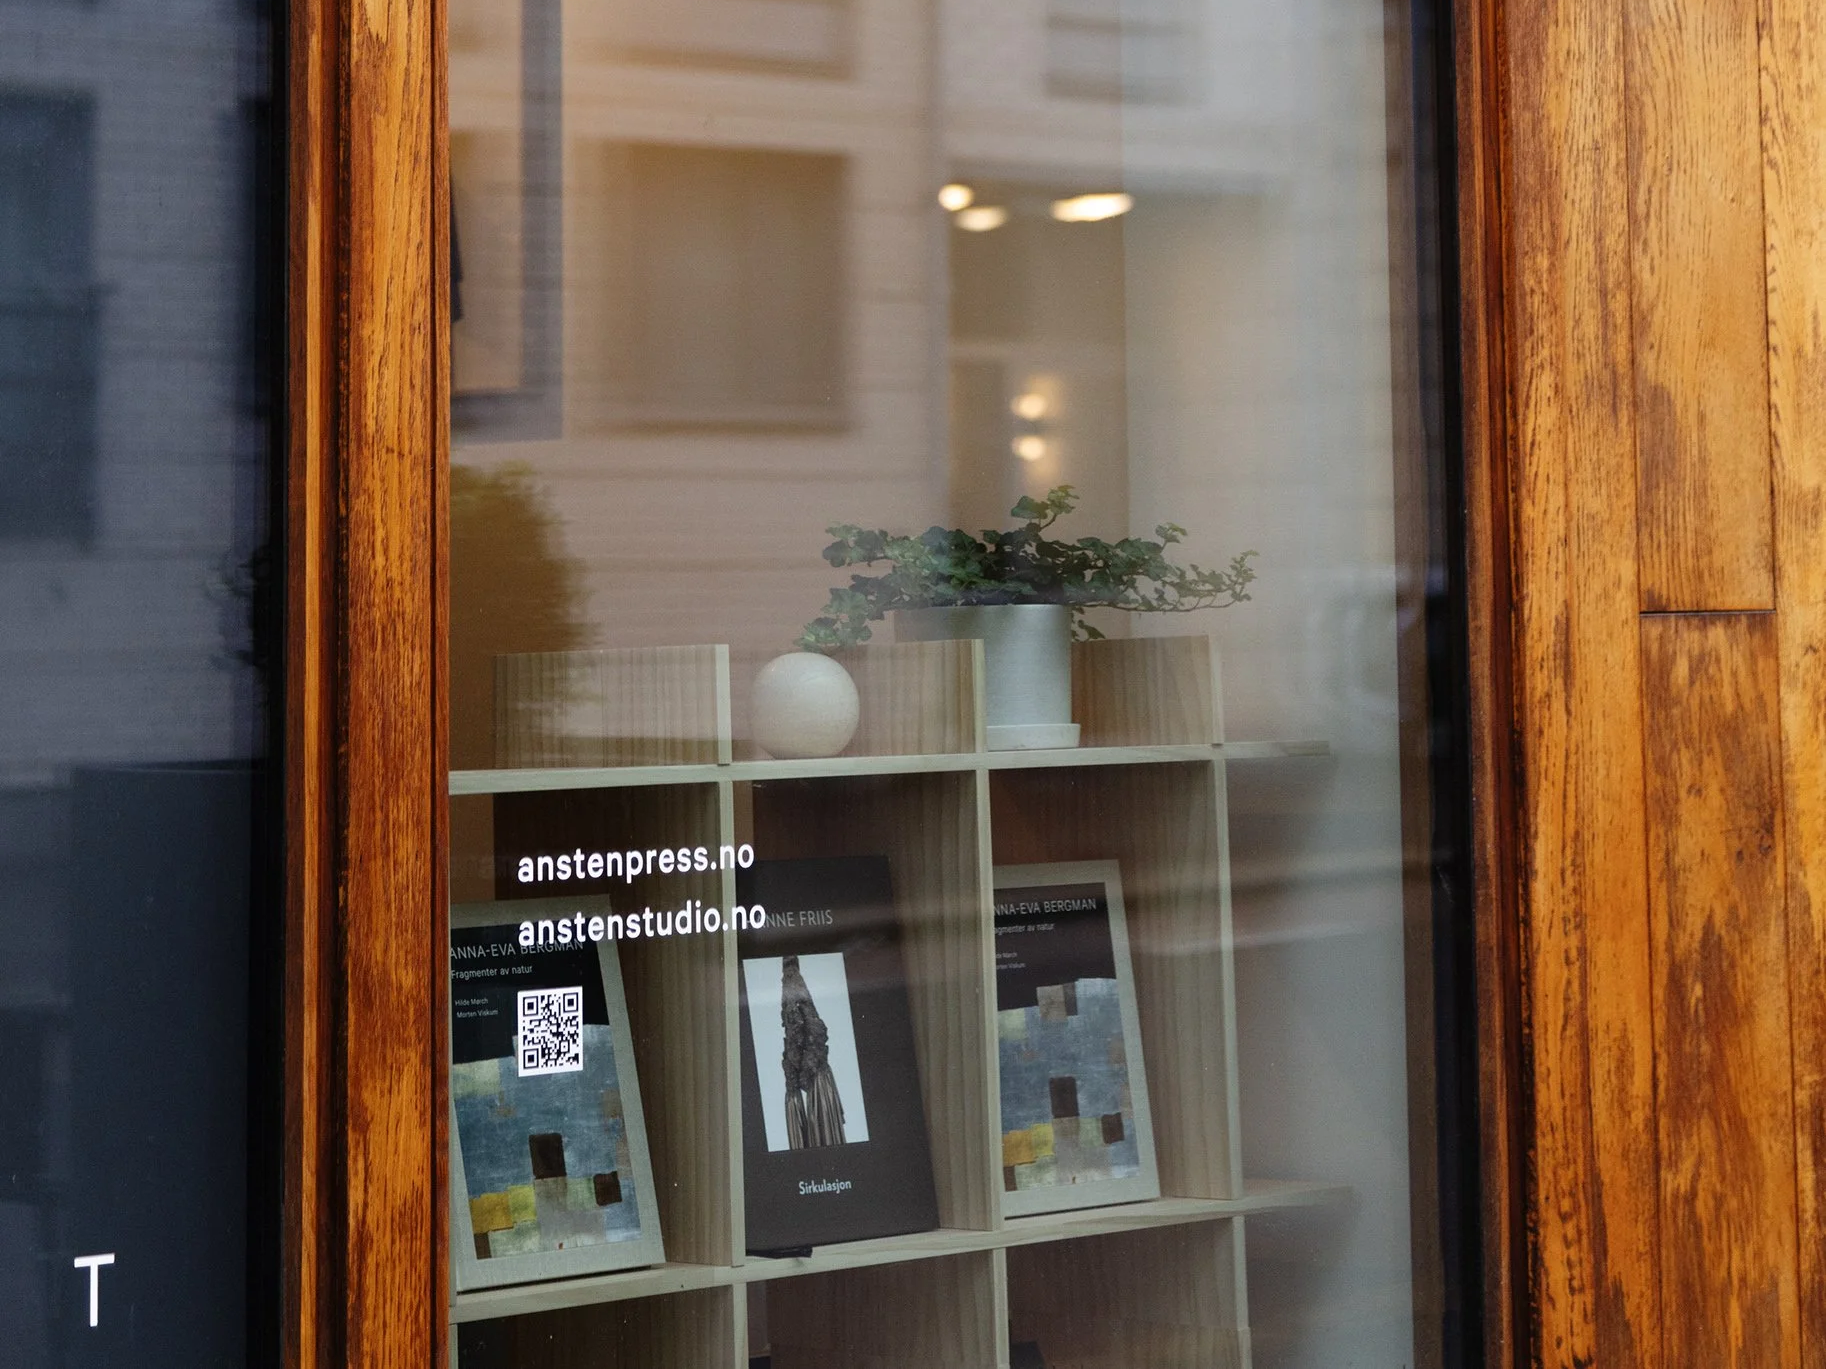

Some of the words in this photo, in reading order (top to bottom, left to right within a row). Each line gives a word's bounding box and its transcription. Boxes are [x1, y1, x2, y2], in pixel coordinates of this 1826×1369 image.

[517, 843, 755, 884] anstenpress.no
[994, 902, 1041, 916] NNA-EVA
[1043, 898, 1097, 913] BERGMAN
[518, 900, 766, 947] anstenstudio.no
[799, 909, 834, 927] FRIIS
[450, 943, 516, 960] ANNA-EVA
[451, 967, 498, 981] Fragmenter
[499, 967, 510, 976] av
[511, 965, 533, 975] natur
[798, 1178, 853, 1195] Sirkulasjon
[73, 1253, 116, 1327] T
